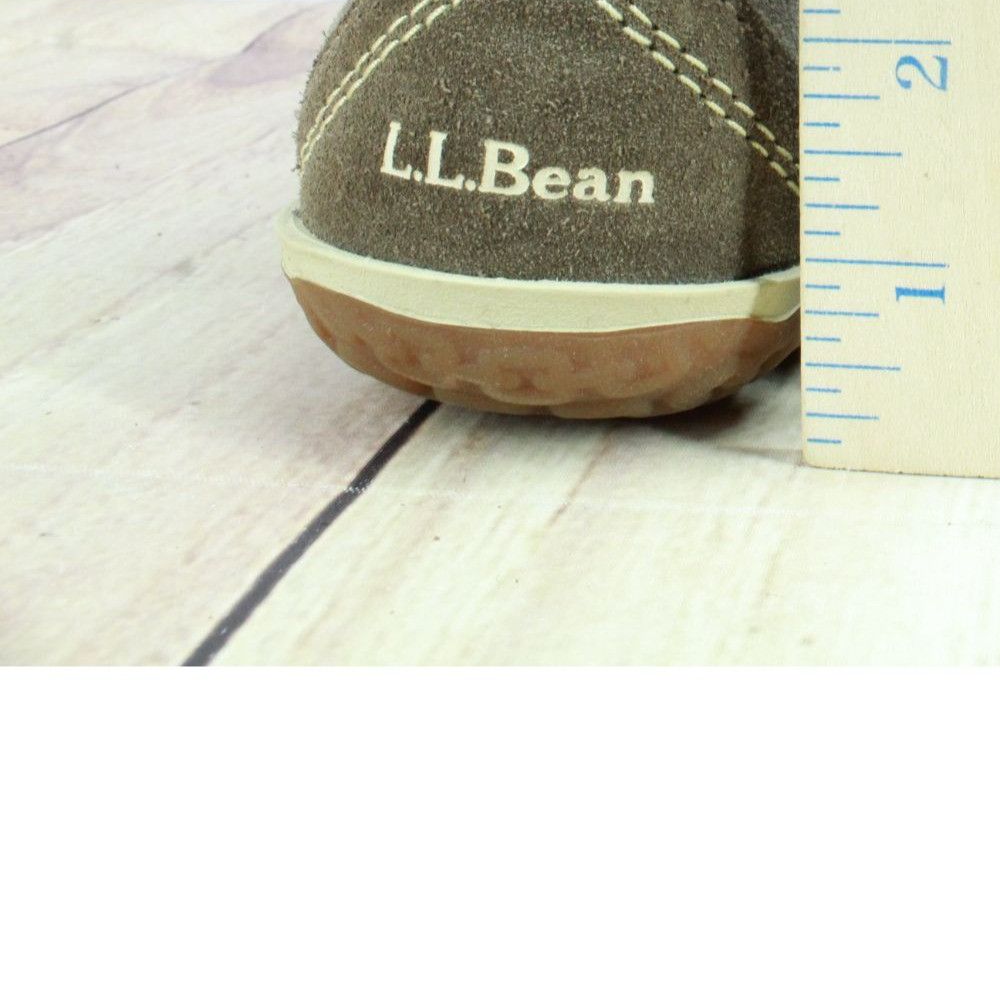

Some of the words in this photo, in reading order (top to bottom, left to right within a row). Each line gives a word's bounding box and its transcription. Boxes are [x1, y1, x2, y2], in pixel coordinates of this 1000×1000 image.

[895, 55, 948, 91] 2
[380, 121, 654, 204] L.L.Bean
[895, 281, 946, 304] 1
